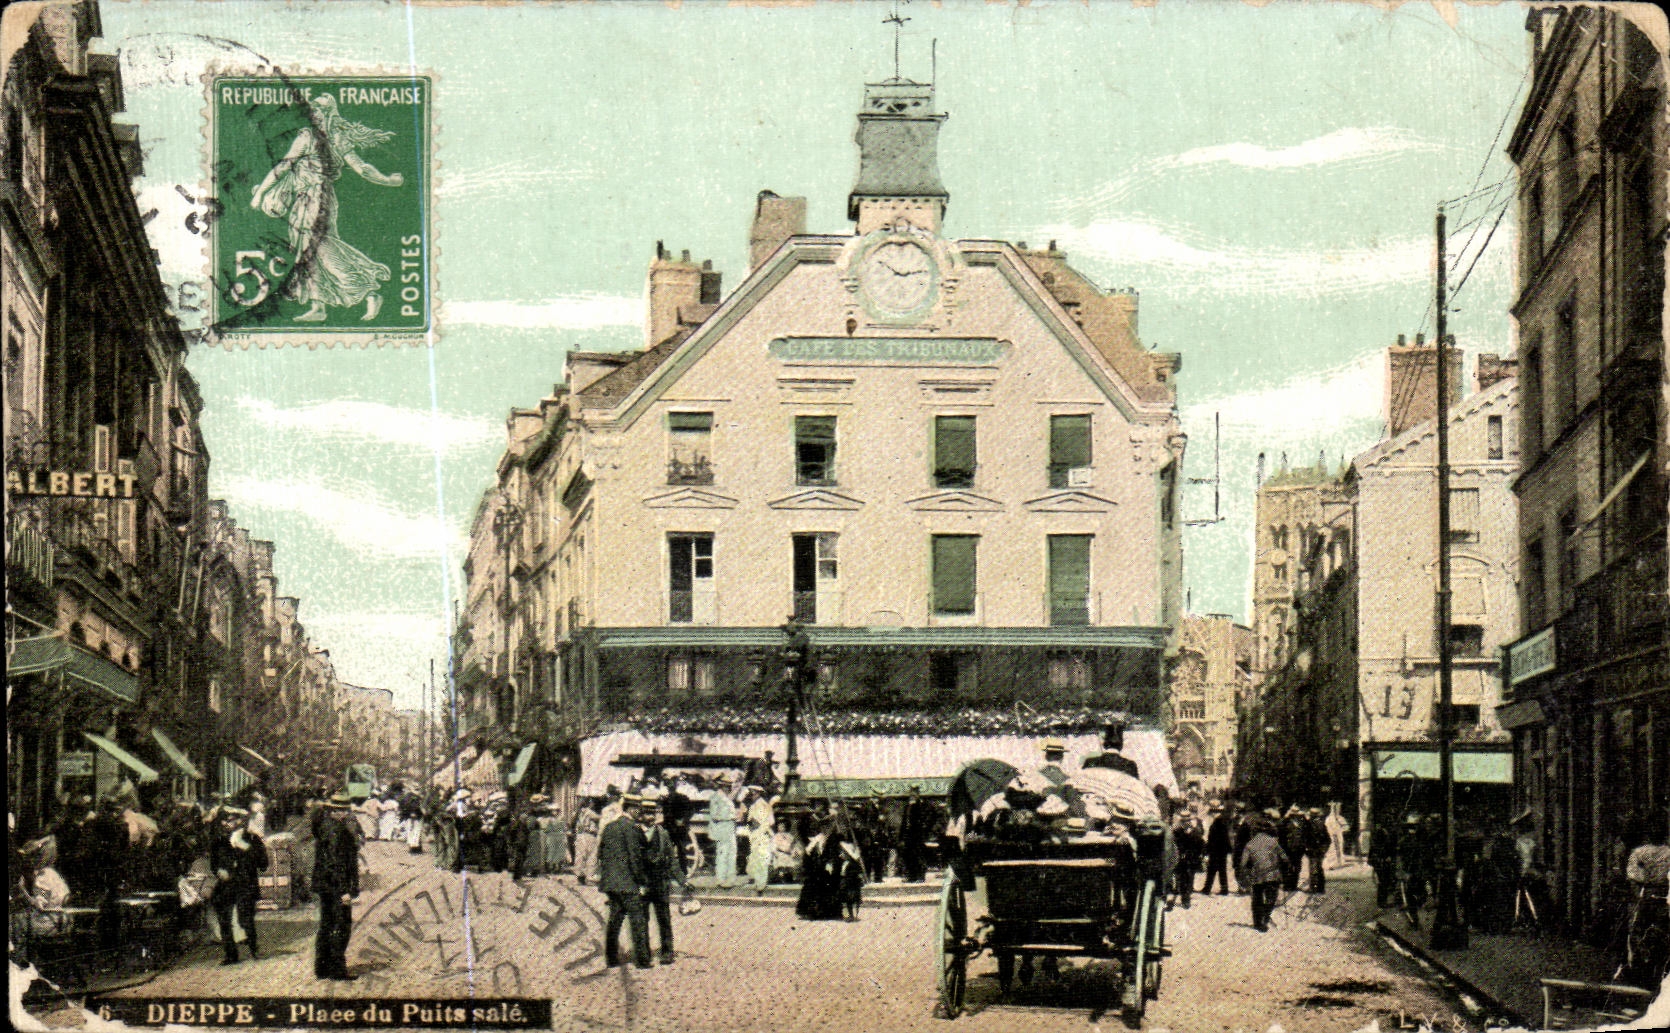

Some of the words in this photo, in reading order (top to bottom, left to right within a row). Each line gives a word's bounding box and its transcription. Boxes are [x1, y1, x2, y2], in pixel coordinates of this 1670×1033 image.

[340, 87, 421, 107] FRANÇAISE
[401, 234, 421, 317] POSTES
[6, 471, 138, 498] ALBERT
